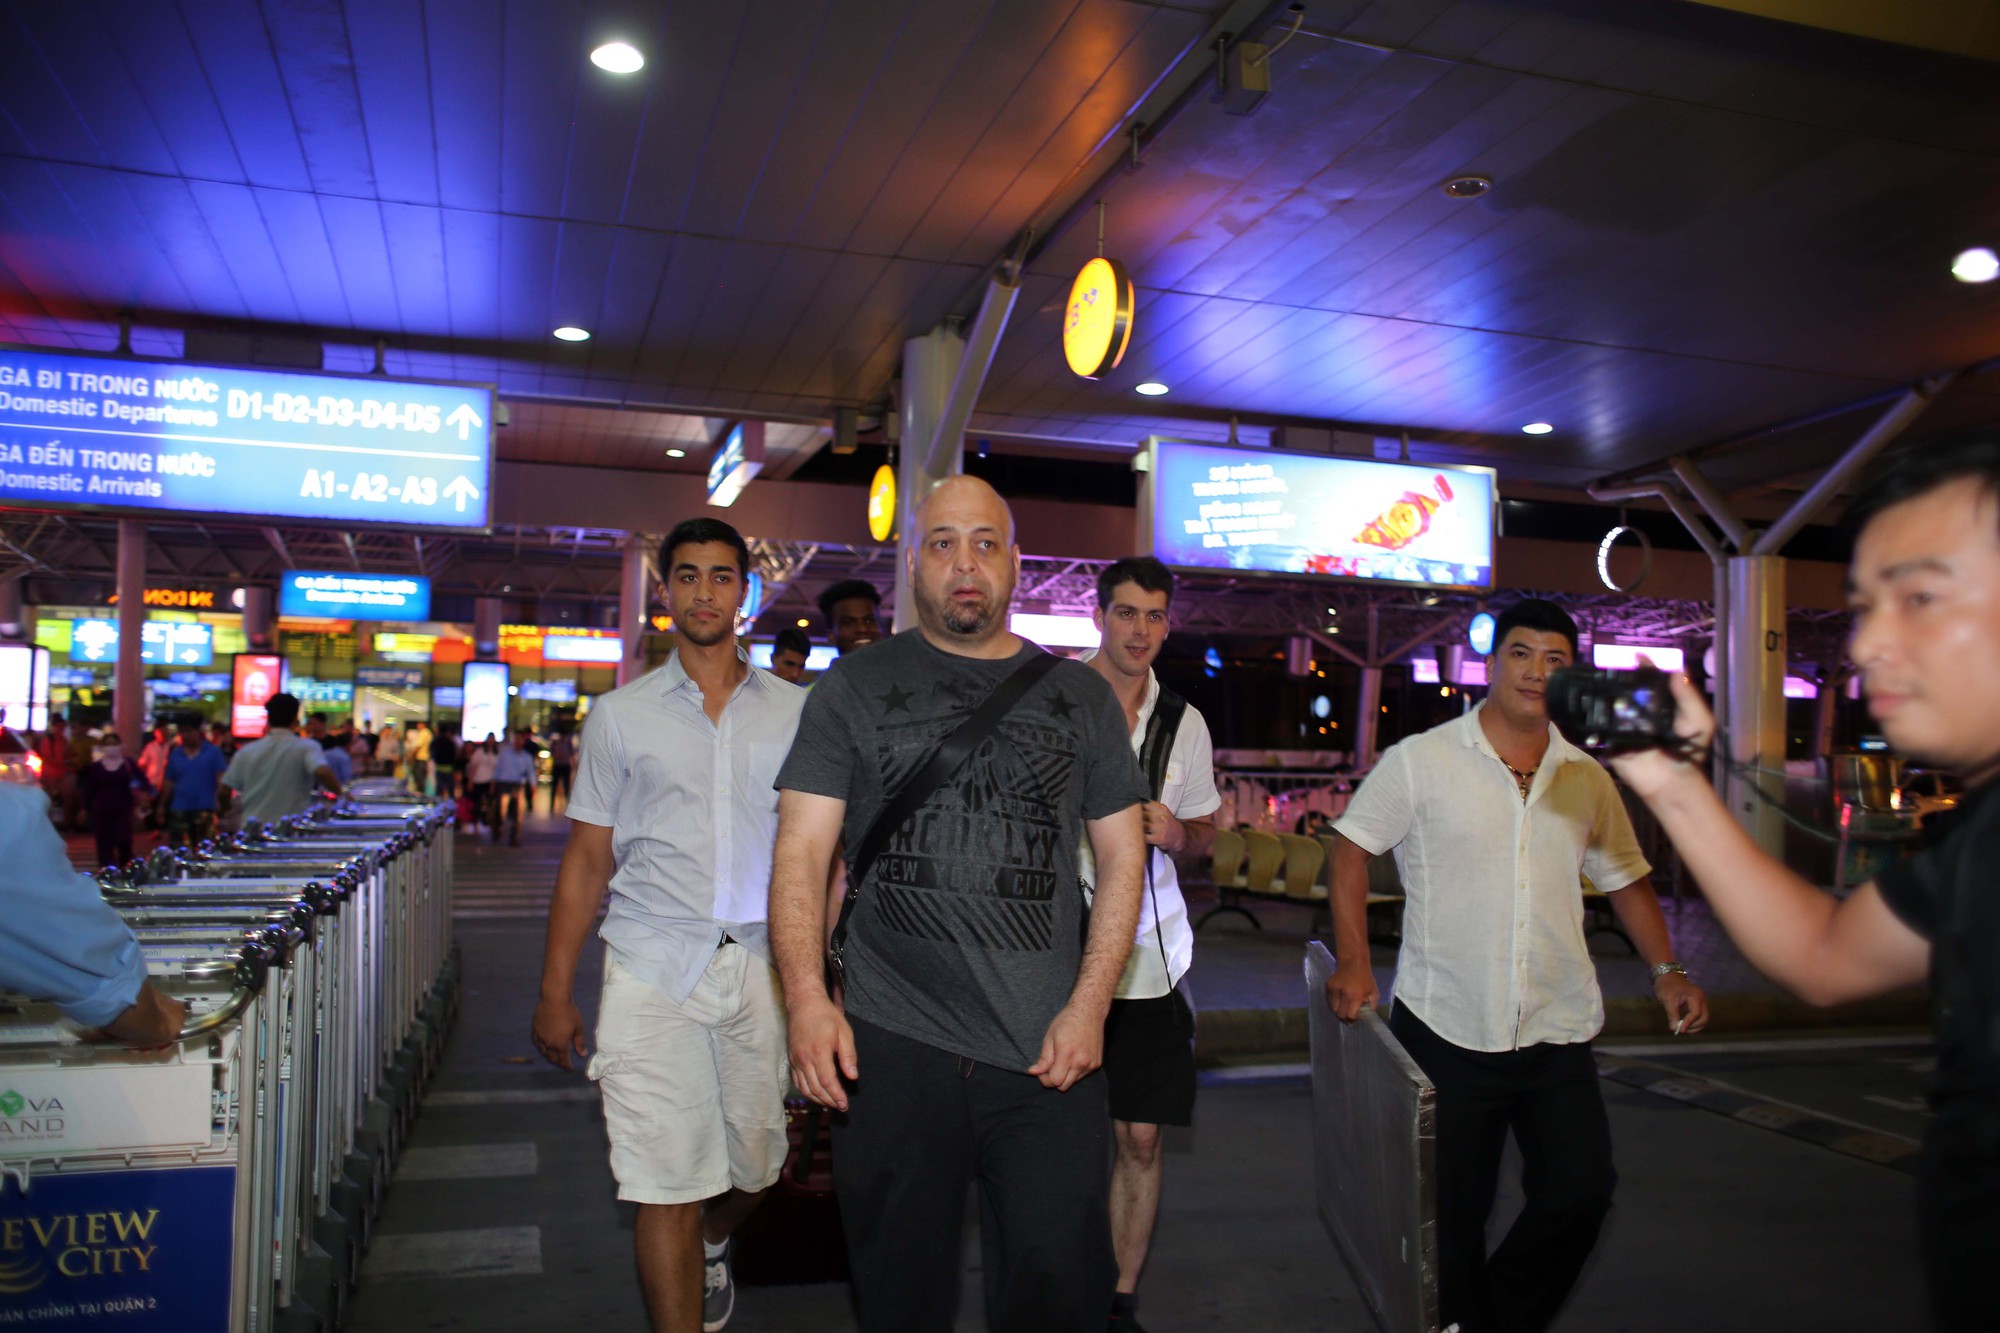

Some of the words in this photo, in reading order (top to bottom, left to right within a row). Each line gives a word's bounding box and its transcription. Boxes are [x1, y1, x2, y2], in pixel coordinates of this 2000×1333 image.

[0, 366, 31, 387] GA
[36, 369, 62, 389] ĐI
[67, 372, 149, 397] TRONG
[0, 391, 98, 418] Domestic
[102, 399, 219, 428] Departures
[29, 440, 74, 468] ĐẾN
[78, 449, 152, 473] TRONG
[87, 474, 163, 498] Arrivals
[878, 857, 918, 882] NEW
[1013, 872, 1055, 898] CITY
[3, 1209, 160, 1249] EVIEW
[57, 1245, 158, 1277] CITY
[104, 1297, 144, 1313] QUẬN
[148, 1298, 157, 1309] 2
